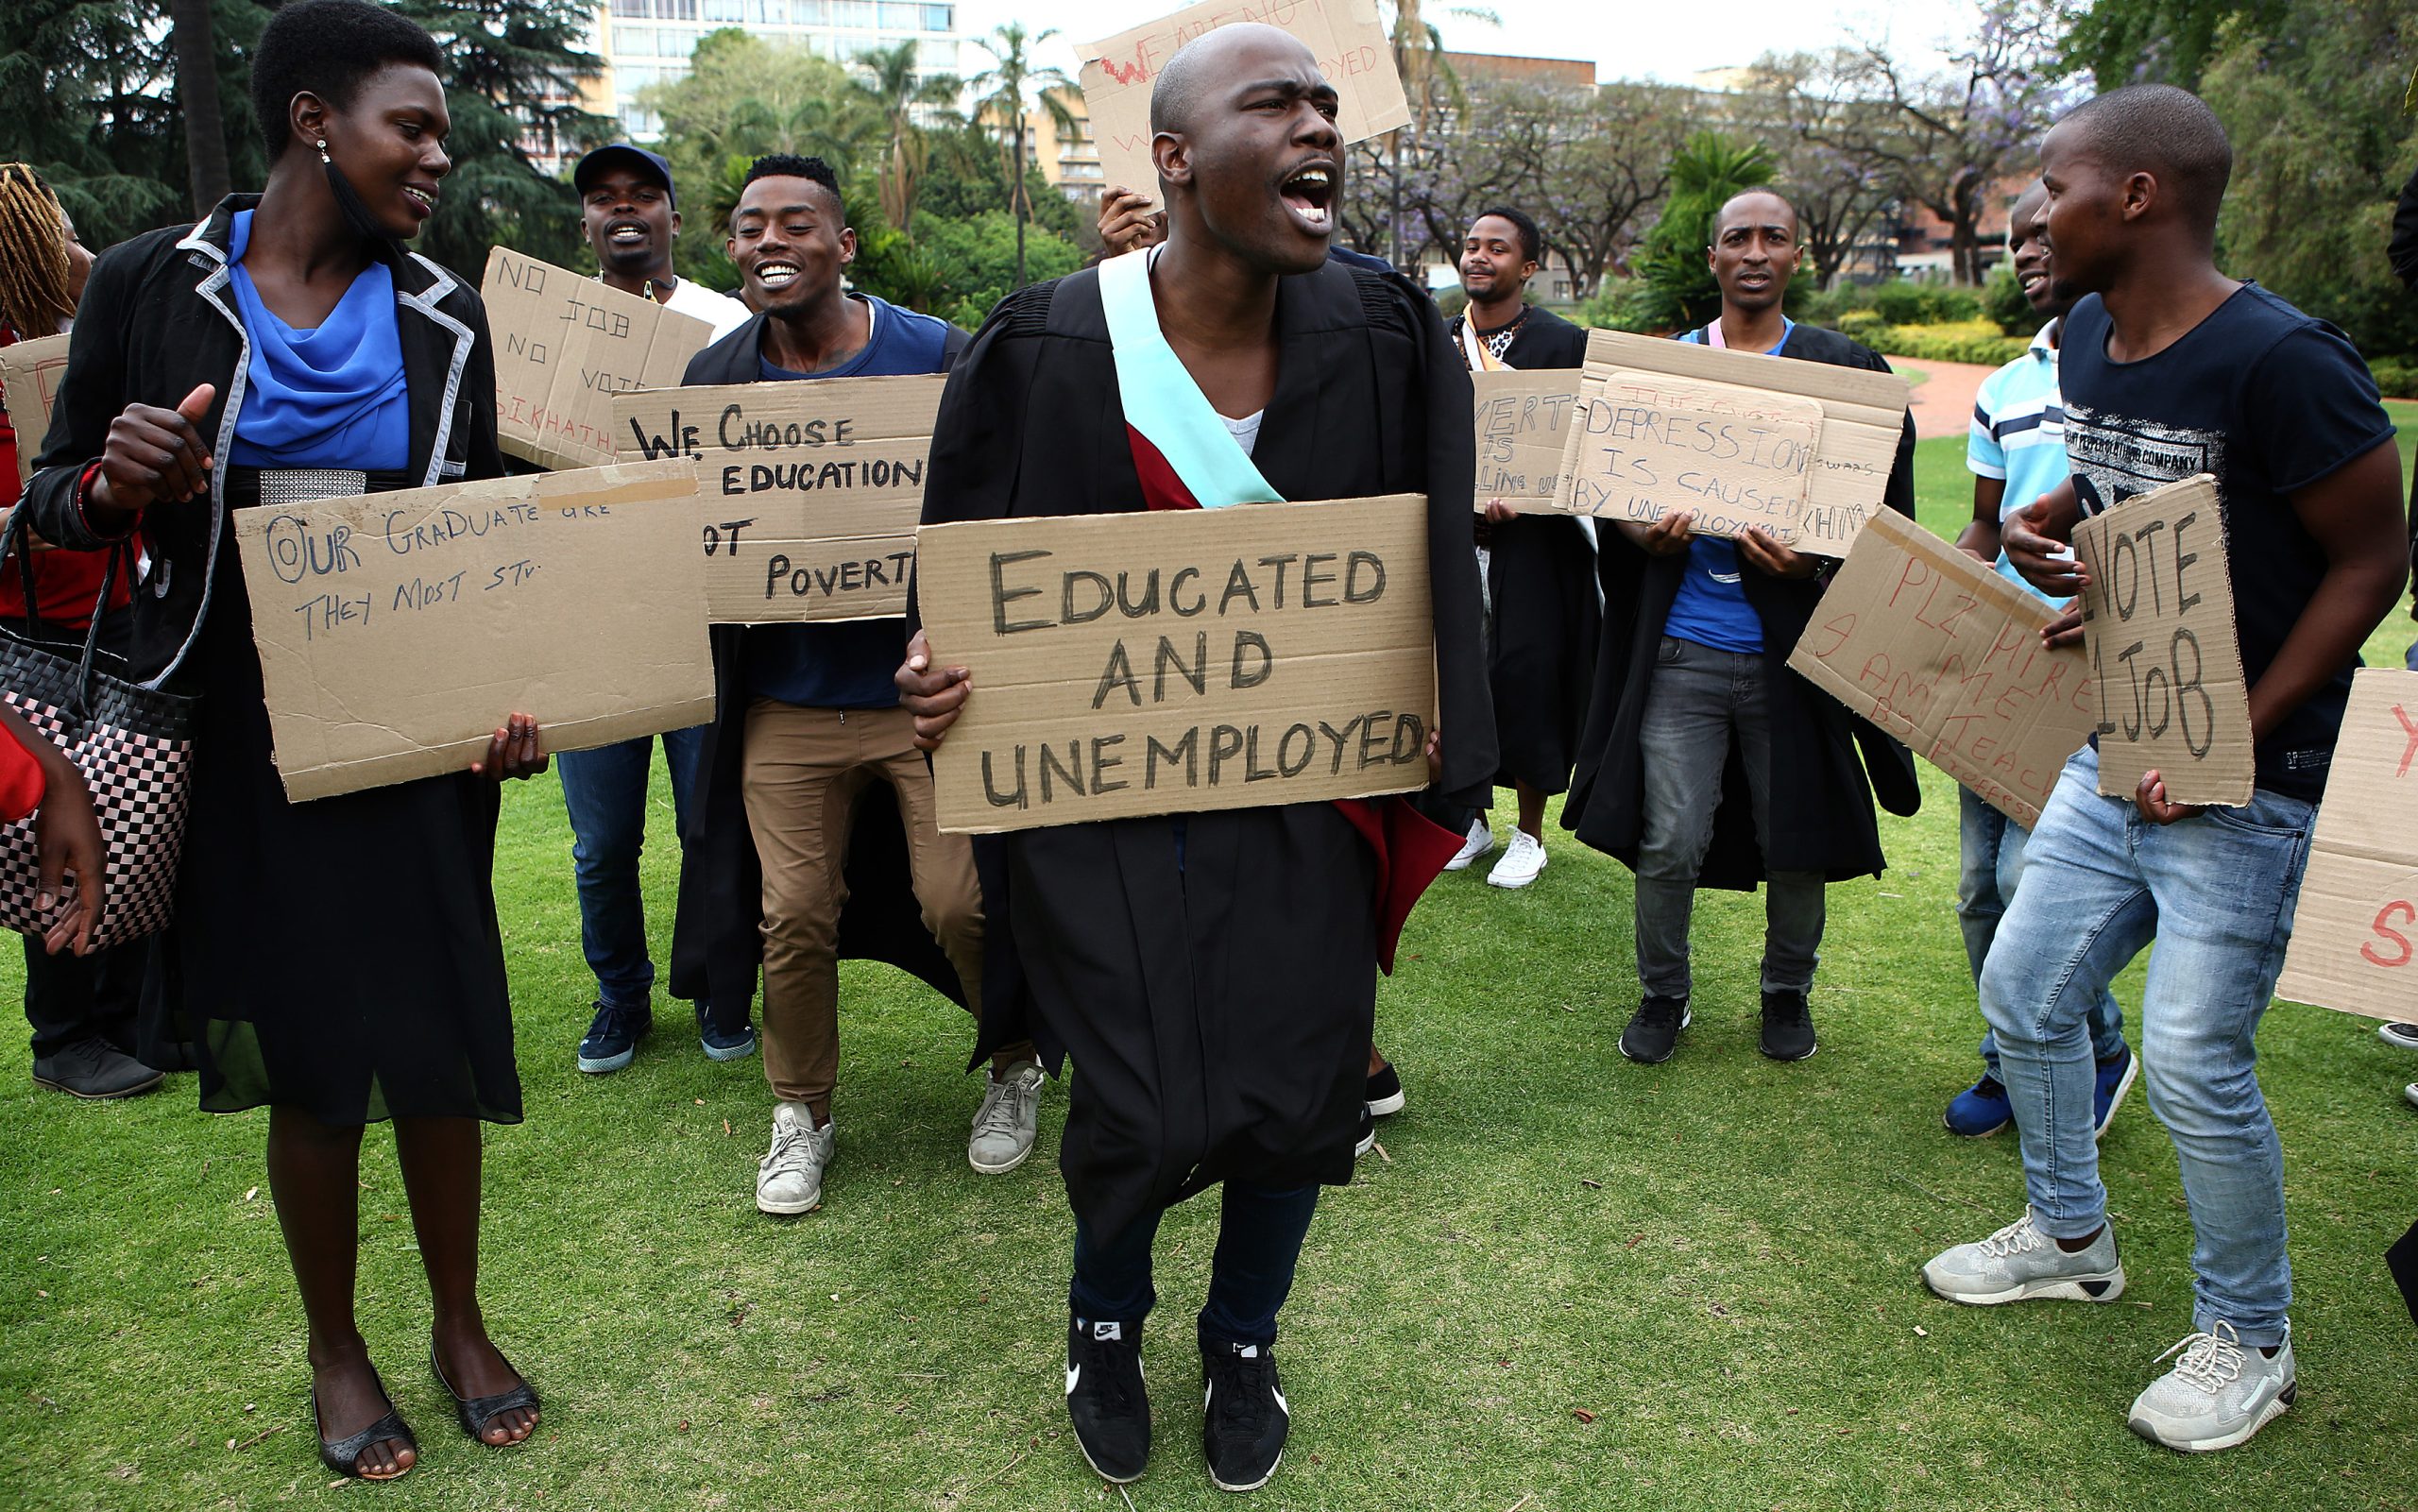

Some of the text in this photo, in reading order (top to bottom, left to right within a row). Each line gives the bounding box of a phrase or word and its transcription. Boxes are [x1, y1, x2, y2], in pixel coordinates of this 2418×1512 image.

[498, 256, 546, 297] NO
[507, 333, 546, 365] NO
[559, 299, 630, 339] JOB
[629, 404, 856, 462] WE CHOOSE
[1587, 399, 1810, 474] DEPRESSION
[2142, 449, 2198, 470] COMPANY
[723, 458, 924, 496] EDUCATION
[1574, 478, 1612, 514] BY
[1602, 447, 1800, 518] IS CAUSED
[266, 515, 361, 585] OUR
[384, 503, 539, 556] GRADUATE
[703, 518, 758, 556] OT
[2088, 512, 2201, 622] VOTE
[295, 591, 372, 641] THEY
[393, 570, 467, 612] MOST
[765, 552, 914, 600] POVERT
[988, 549, 1388, 637] EDUCATED
[1889, 556, 2093, 714] PLZ HIRE
[1091, 630, 1275, 710] AND
[1859, 653, 1929, 717] AM
[1933, 654, 2035, 722] ME
[980, 709, 1425, 811] UNEMPLOYED
[1930, 739, 2037, 828] Proffess
